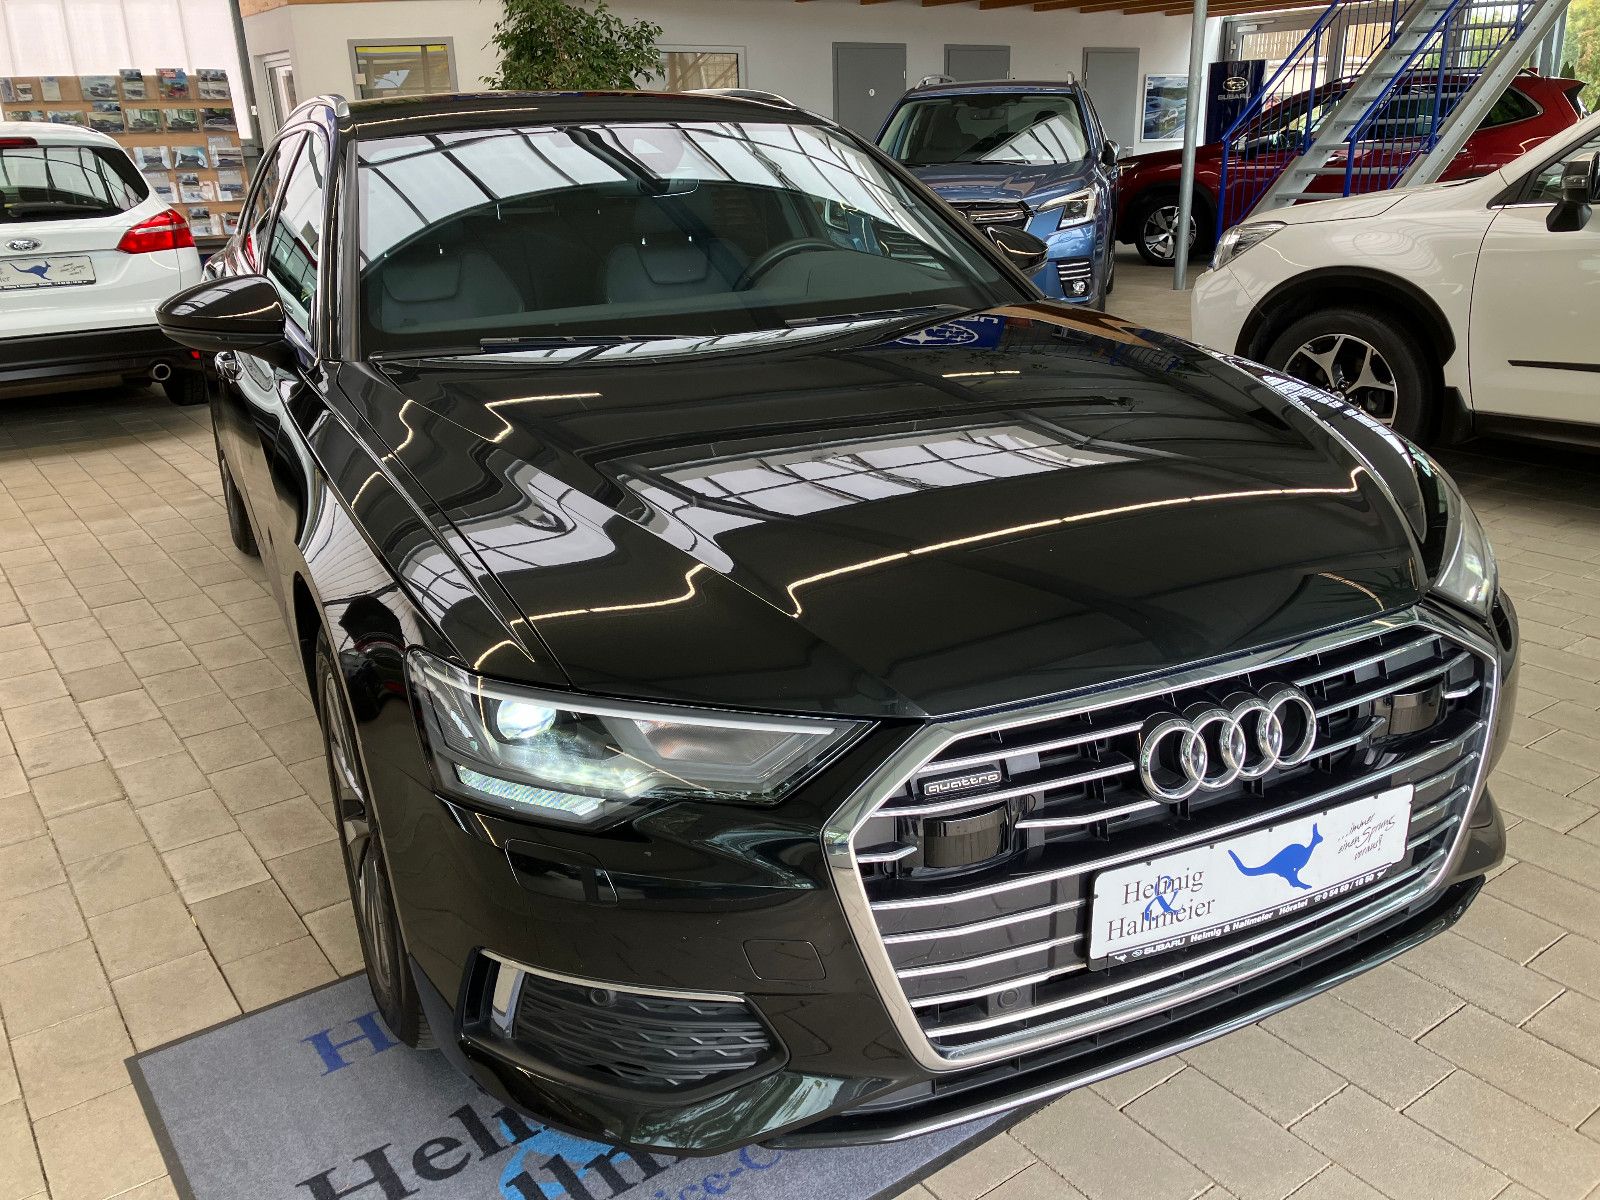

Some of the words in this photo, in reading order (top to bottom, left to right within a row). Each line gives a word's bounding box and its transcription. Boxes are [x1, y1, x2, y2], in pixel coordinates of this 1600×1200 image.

[1217, 92, 1251, 100] SUBARU
[928, 774, 998, 793] quattro
[1122, 867, 1204, 905] Helmig
[1107, 899, 1215, 942] Hallmeier
[1143, 937, 1186, 955] SUBARU
[1190, 927, 1222, 943] Helmig
[1232, 912, 1274, 931] Hallmeier
[301, 1010, 399, 1076] H
